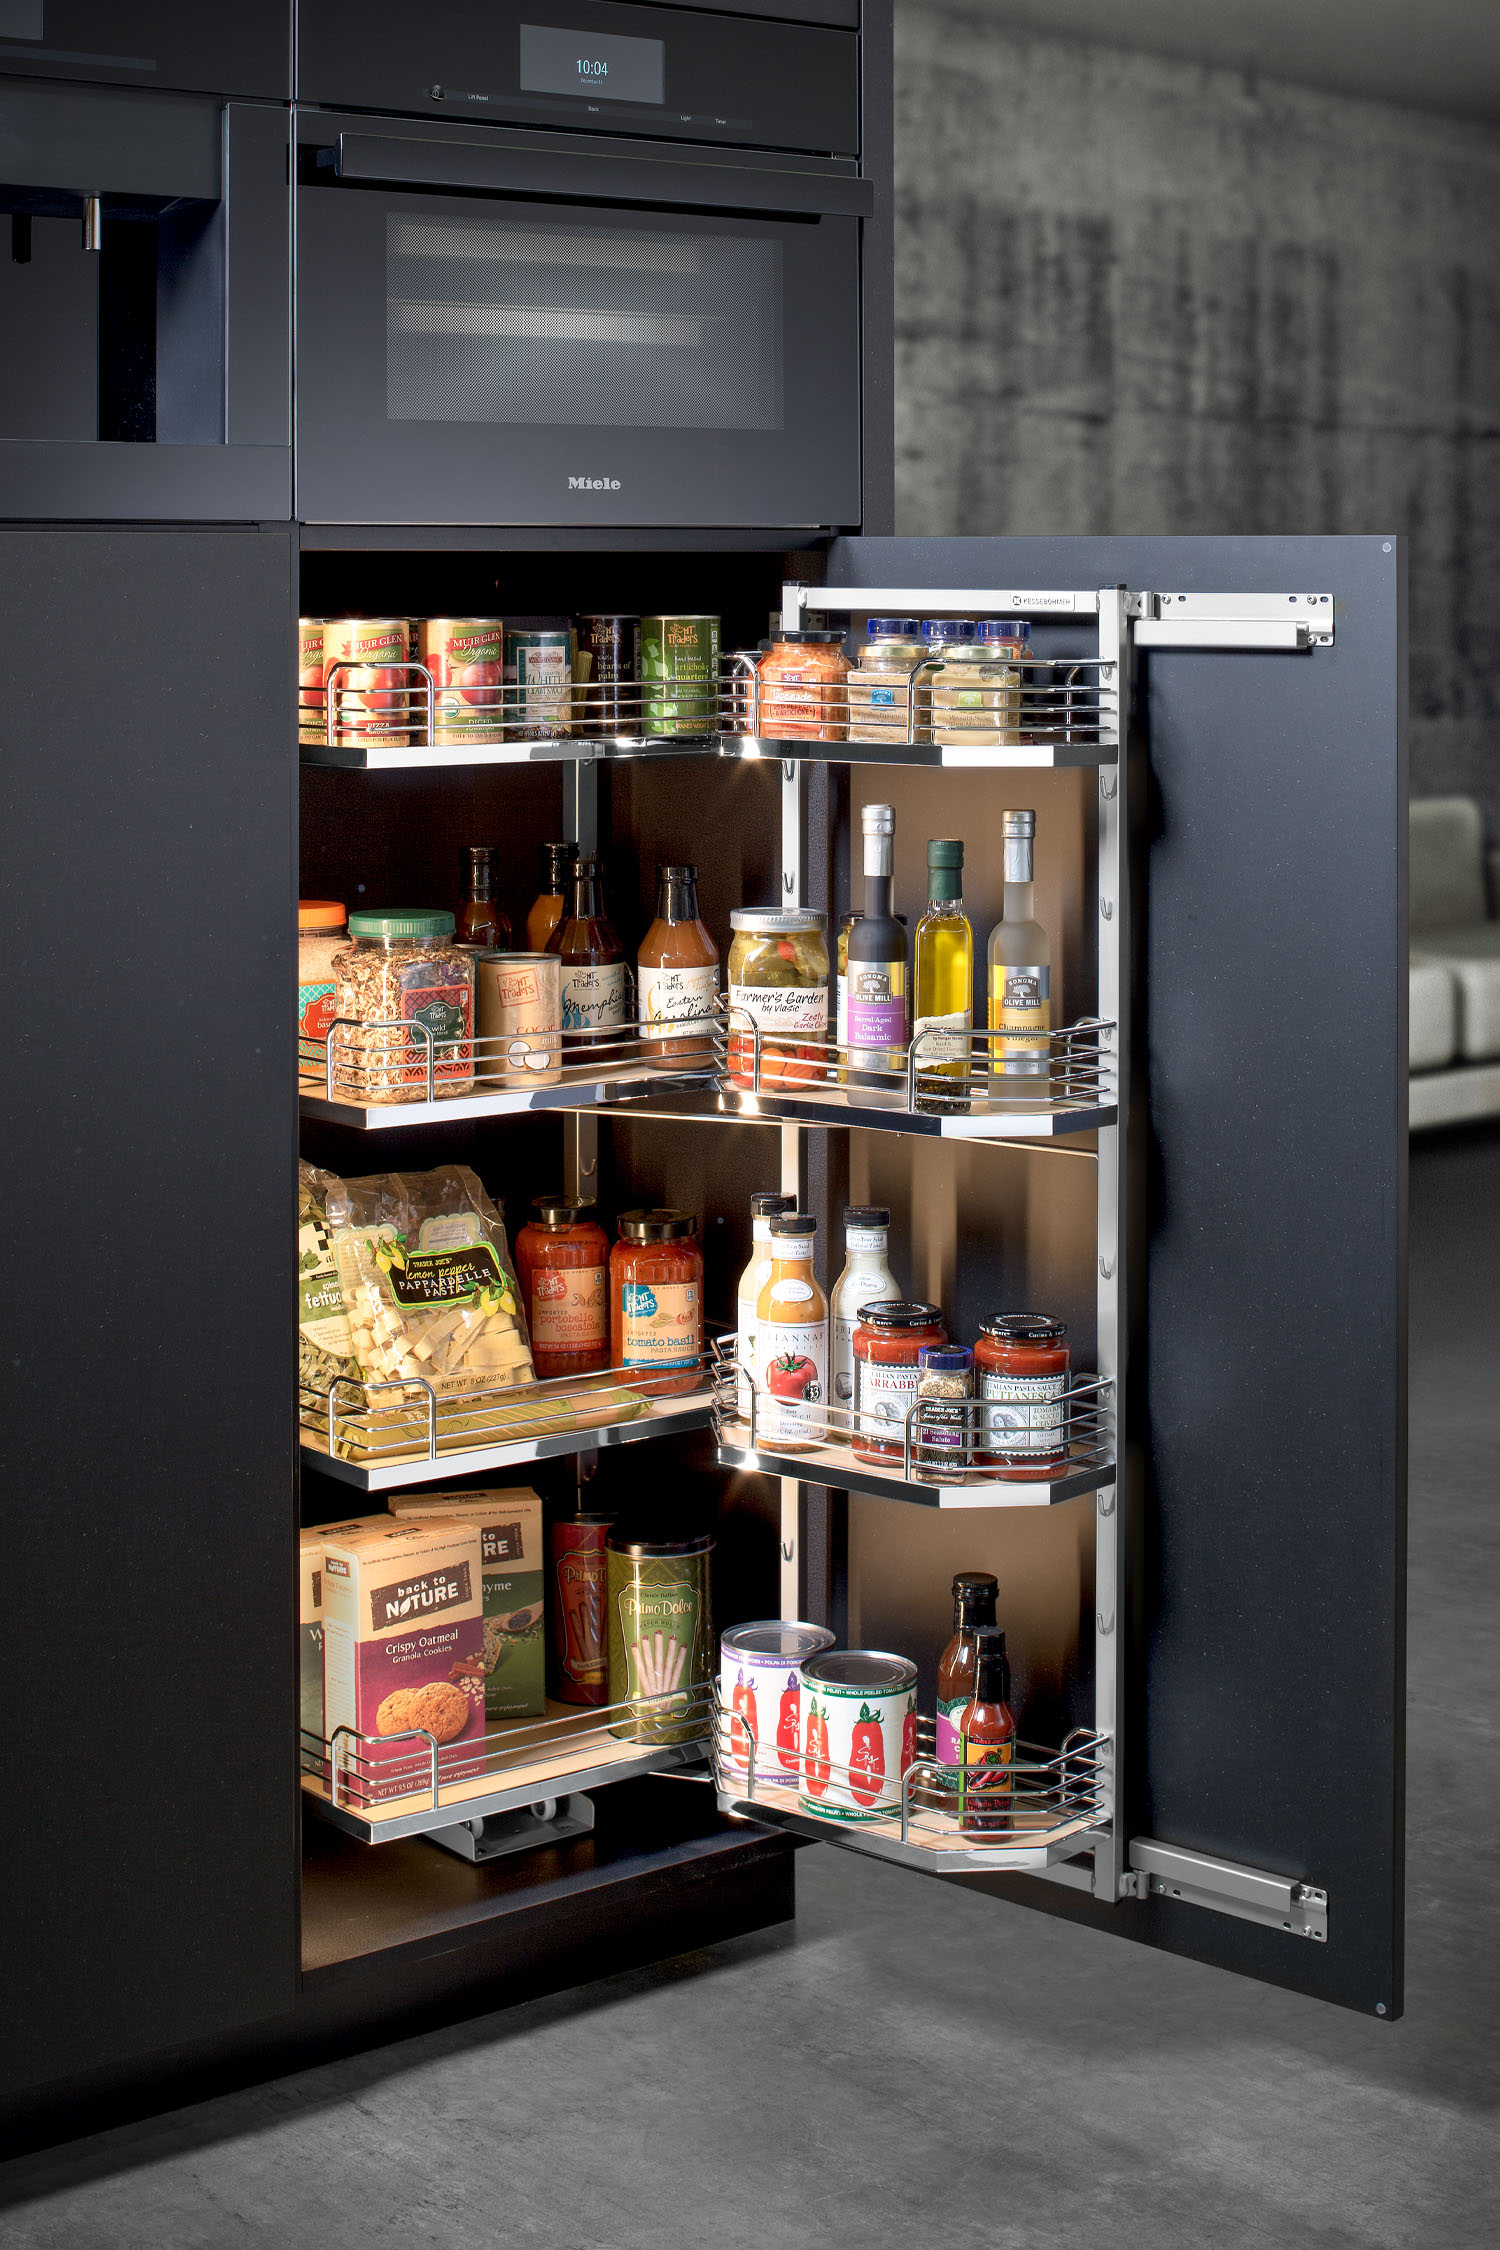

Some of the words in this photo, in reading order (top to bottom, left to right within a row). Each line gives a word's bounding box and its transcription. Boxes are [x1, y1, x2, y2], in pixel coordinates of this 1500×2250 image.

[576, 58, 608, 77] 10:04
[567, 476, 622, 491] Miele
[379, 633, 403, 647] GLEN
[453, 635, 480, 648] MUIR
[481, 631, 501, 643] GLEN
[591, 633, 621, 644] Traders
[668, 633, 698, 645] Traders
[461, 644, 497, 666] Organic
[623, 660, 632, 670] of
[598, 672, 619, 681] palm
[675, 673, 709, 681] quarters
[770, 689, 816, 702] Tapenade
[516, 976, 530, 987] HT
[586, 971, 598, 980] HT
[859, 972, 888, 983] SONOMA
[1008, 977, 1037, 986] SONOMA
[572, 978, 600, 988] Traders
[657, 981, 684, 990] Taders
[502, 984, 535, 1000] Traders
[736, 989, 783, 1004] Farmer's
[784, 991, 824, 1005] Garden
[855, 994, 874, 1002] OLIVE
[874, 994, 891, 1002] MILL
[563, 988, 623, 1020] Memphis
[666, 995, 704, 1009] Eastern
[653, 1003, 713, 1022] Colina
[761, 1003, 773, 1015] by
[801, 1012, 824, 1022] Zesty
[854, 1015, 892, 1024] Barrel-Aged
[431, 1024, 446, 1032] wild
[862, 1024, 884, 1032] Dark
[998, 1023, 1046, 1031] Champagne
[854, 1032, 892, 1041] Balsamic
[405, 1259, 436, 1280] lemon
[412, 1260, 434, 1268] TRADER
[398, 1268, 491, 1290] PAPPARDELLE
[322, 1281, 339, 1291] spina
[424, 1284, 467, 1297] PASTA
[537, 1282, 565, 1297] Traders
[304, 1290, 343, 1310] fettuc
[540, 1313, 593, 1326] portobello
[627, 1336, 665, 1347] tomato
[667, 1334, 695, 1347] basil
[764, 1331, 824, 1343] IANNAS
[673, 1345, 695, 1353] SAUCE
[441, 1381, 455, 1390] NET
[470, 1377, 475, 1385] 8
[475, 1375, 486, 1383] OZ
[486, 1373, 507, 1384] (227g)
[869, 1378, 918, 1389] ARRABB
[986, 1382, 1013, 1391] ITALIAN
[1036, 1383, 1057, 1392] SAUCE
[986, 1389, 1058, 1400] PUTTANESCA
[481, 1532, 496, 1541] to
[397, 1580, 429, 1598] back
[432, 1576, 446, 1586] to
[658, 1598, 694, 1617] Dolce
[385, 1640, 417, 1655] Crispy
[418, 1628, 459, 1648] Oatmeal
[392, 1650, 421, 1664] Granola
[423, 1644, 453, 1657] Cookies
[453, 1766, 480, 1778] enjoyment
[377, 1787, 388, 1797] NET
[388, 1785, 397, 1794] WT
[406, 1781, 414, 1789] OZ
